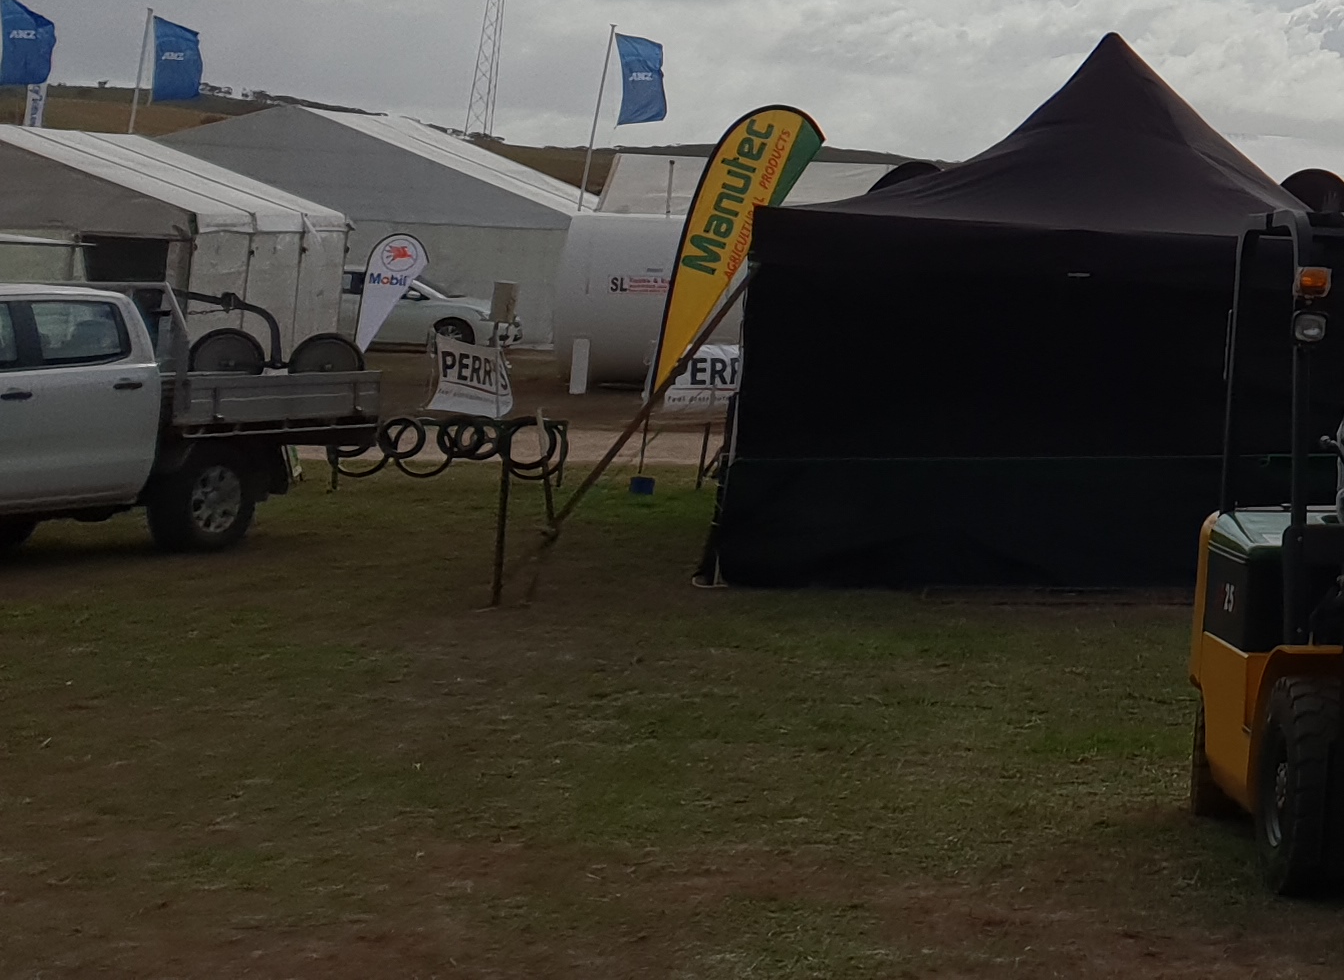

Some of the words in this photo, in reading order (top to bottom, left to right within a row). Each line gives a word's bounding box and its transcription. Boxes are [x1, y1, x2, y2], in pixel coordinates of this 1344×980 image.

[758, 128, 792, 190] PRODUCTS
[681, 118, 775, 276] Manutec
[368, 272, 409, 287] Mobil
